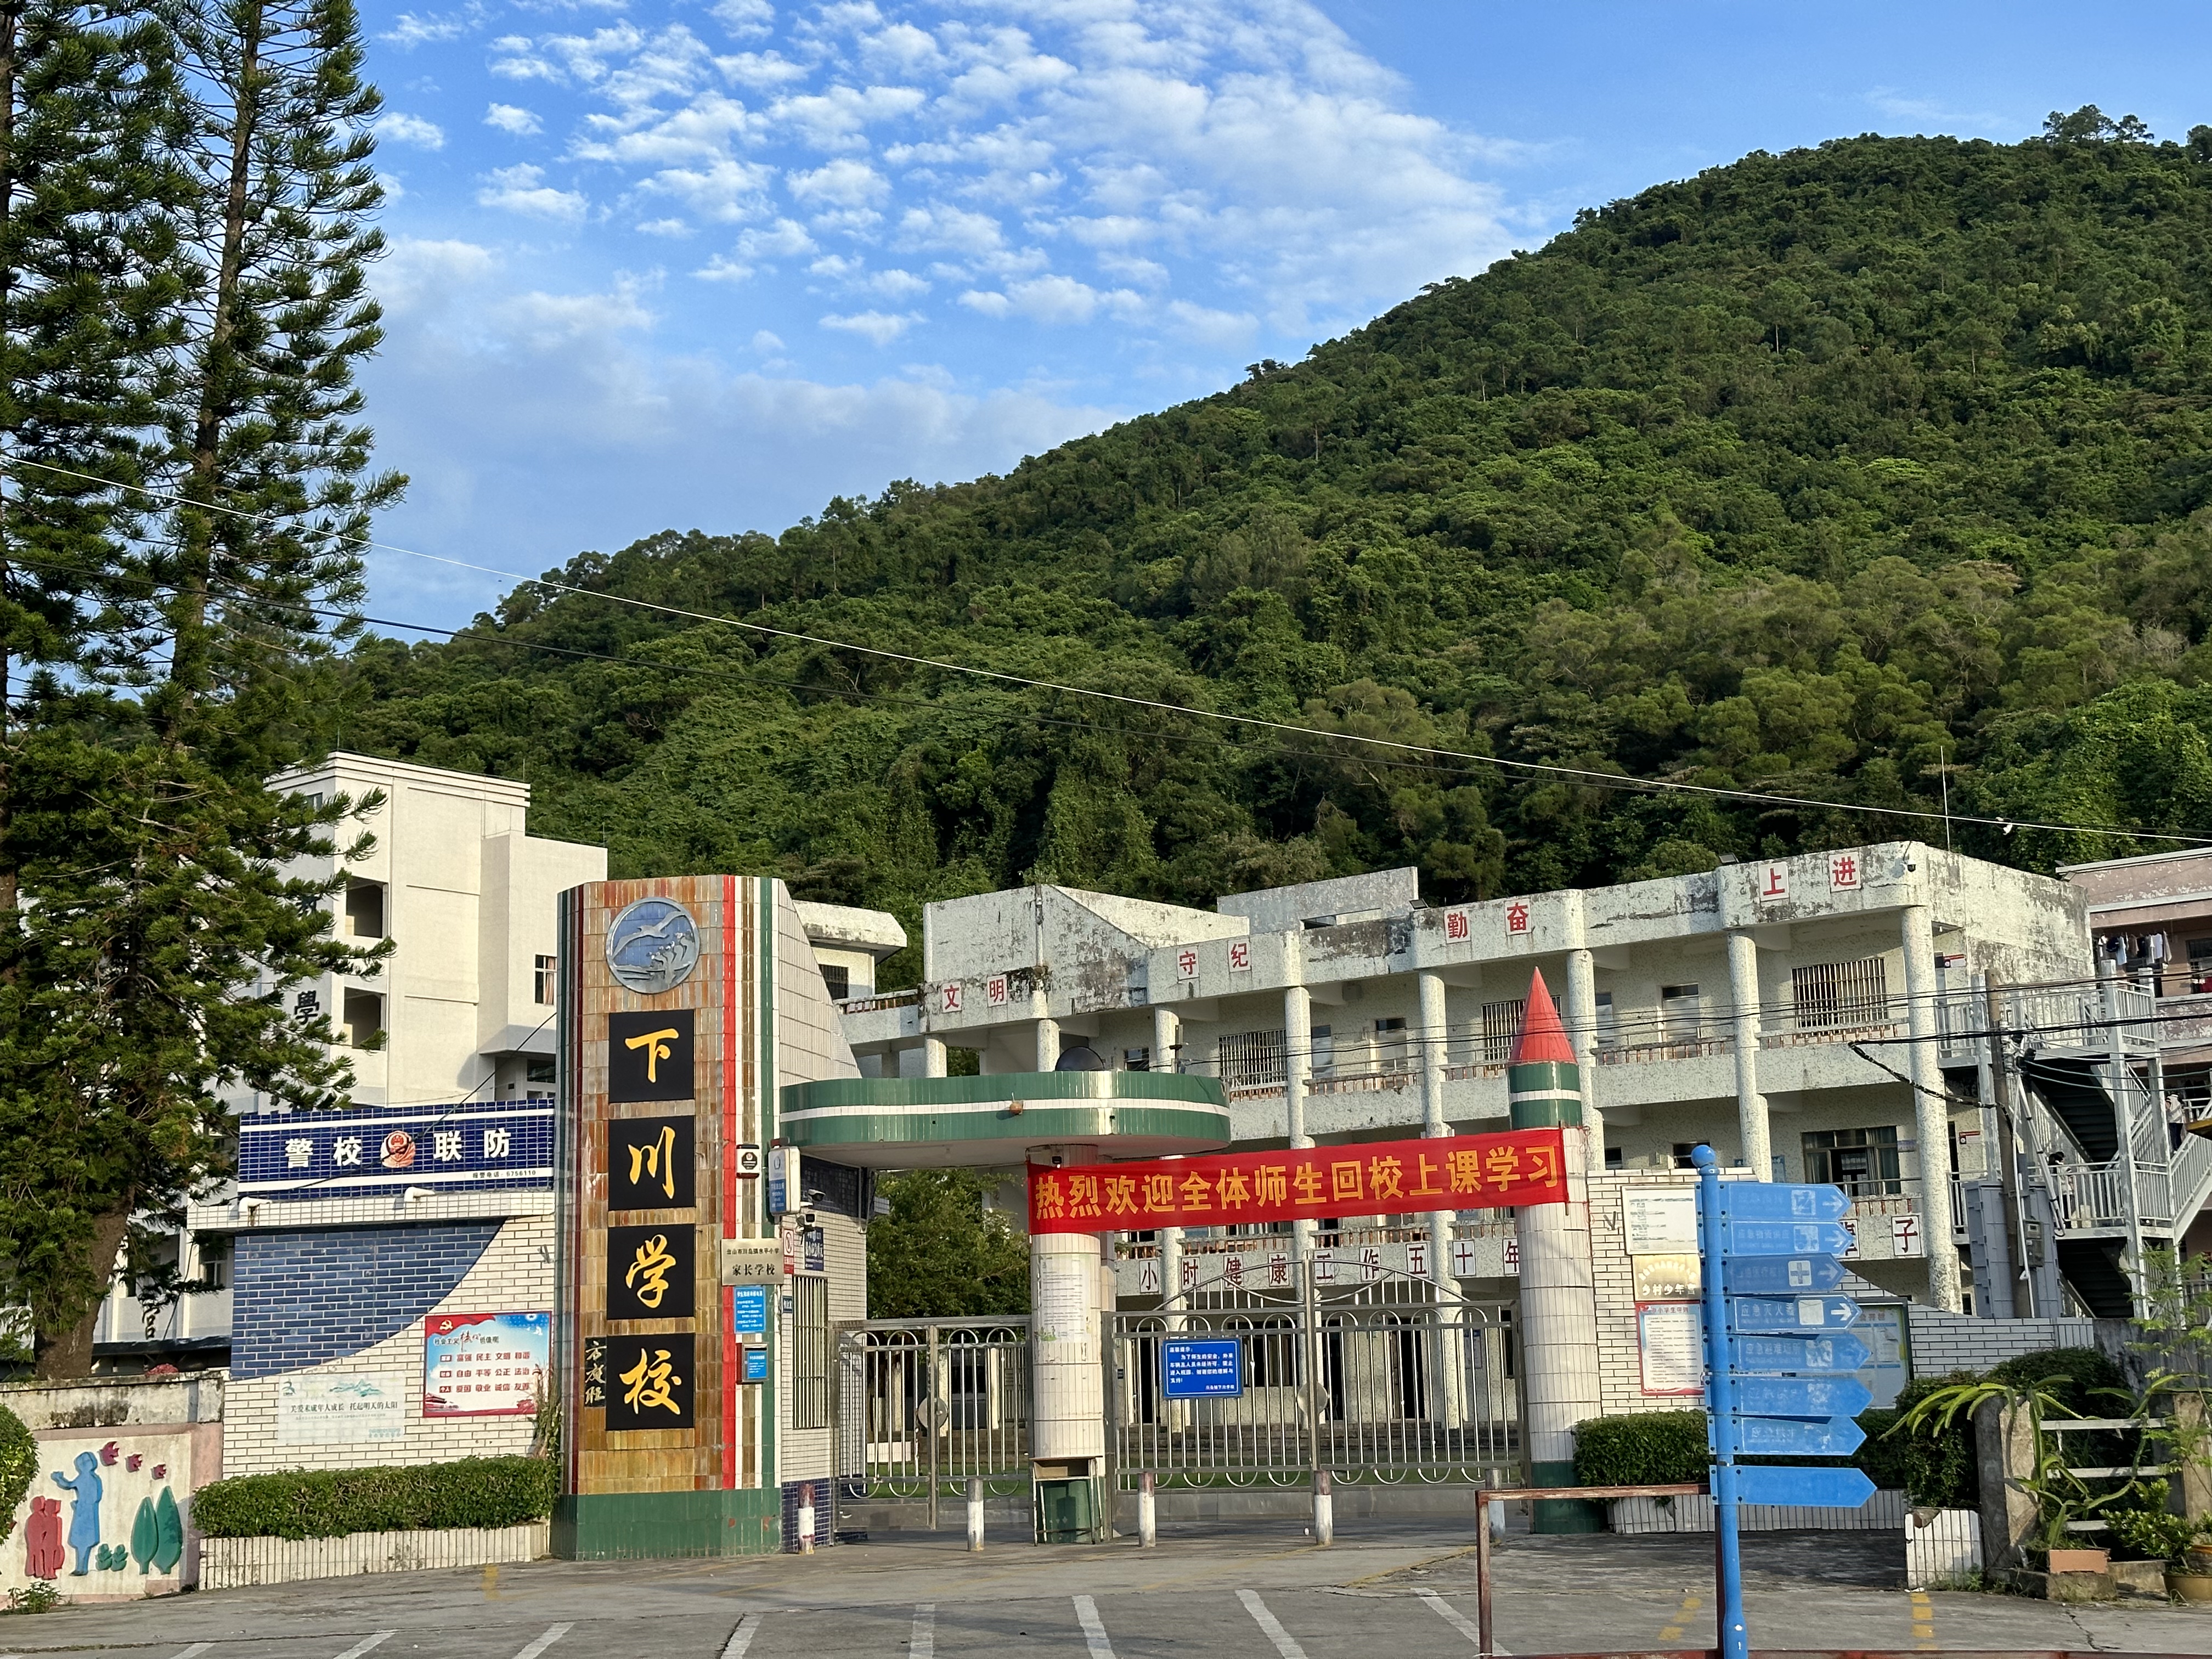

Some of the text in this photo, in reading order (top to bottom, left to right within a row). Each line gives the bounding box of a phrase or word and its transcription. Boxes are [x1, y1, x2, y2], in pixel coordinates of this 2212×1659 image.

[943, 856, 1857, 1011] 文明 守纪 勤奋 上进
[1035, 1146, 1558, 1220] 热烈欢迎全体师生回校上课学习
[619, 1028, 682, 1415] 下川学校
[732, 1263, 775, 1276] 家长学校
[1741, 1302, 1795, 1317] 应急灭火器
[476, 1353, 492, 1361] 民主
[290, 1401, 398, 1413] 关爱未成年人成长 托起明天的太阳
